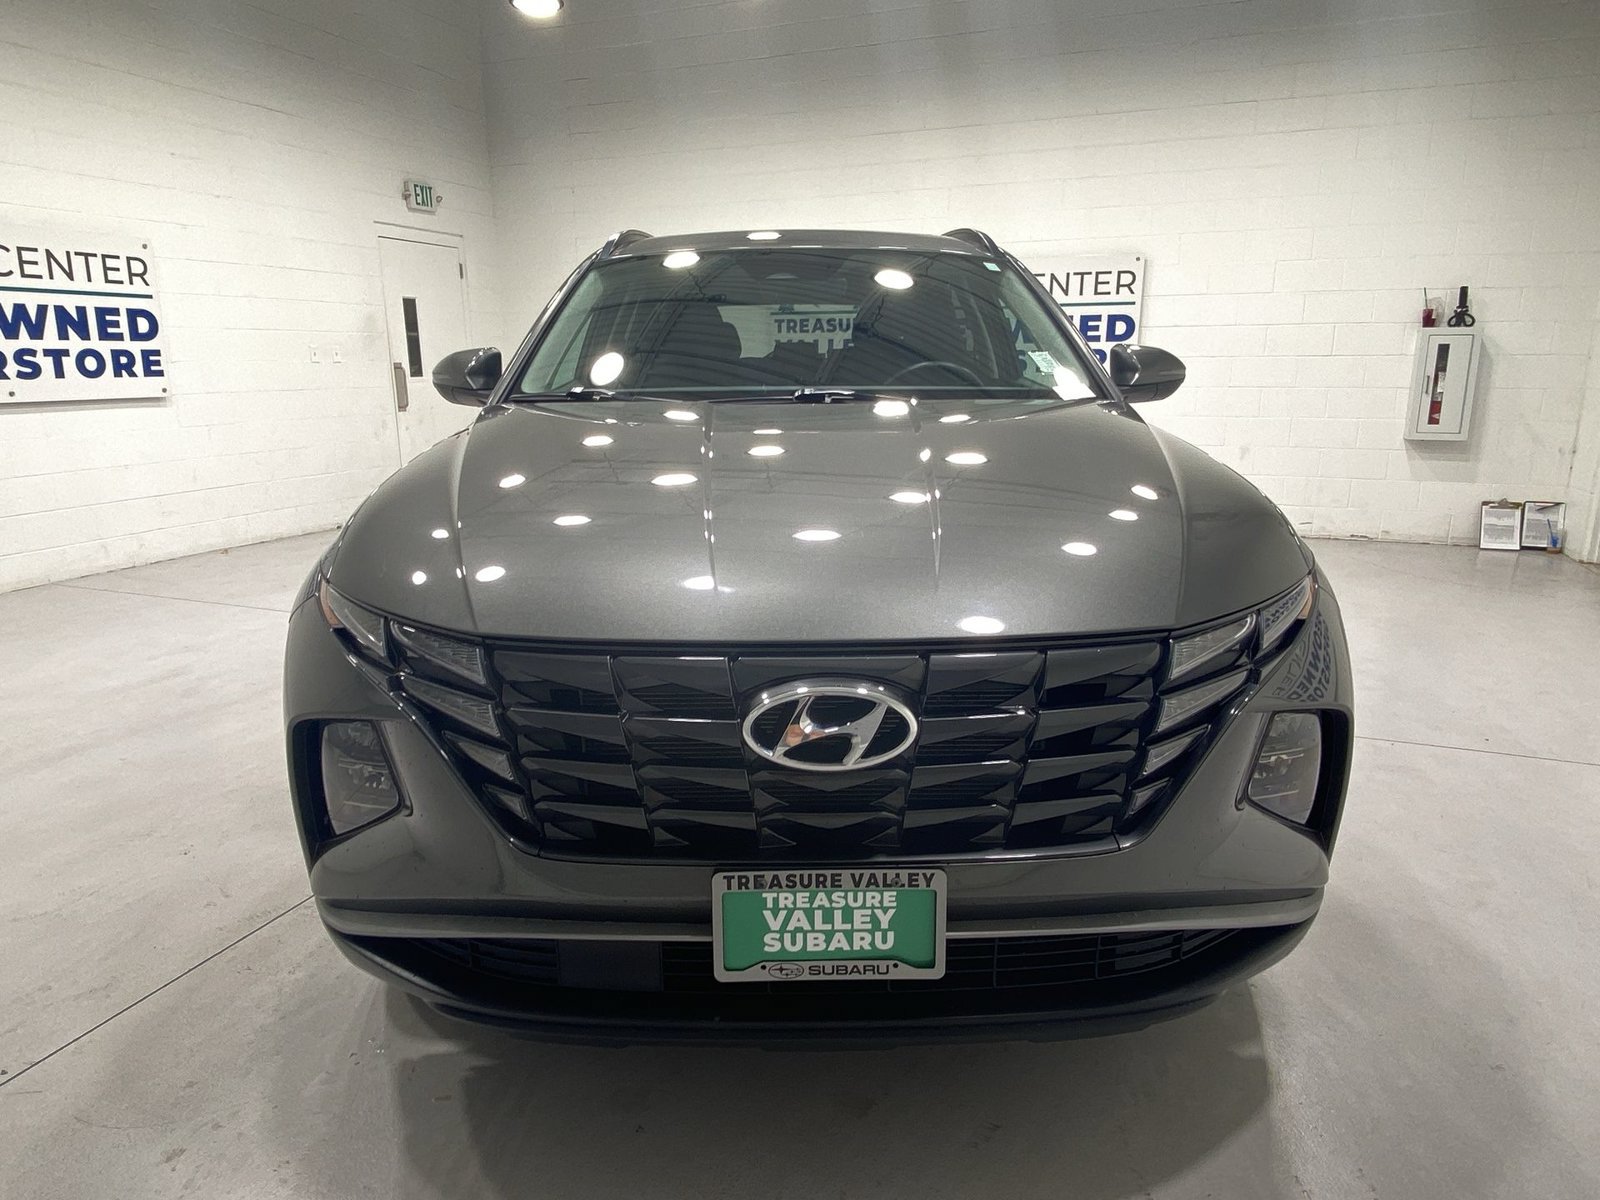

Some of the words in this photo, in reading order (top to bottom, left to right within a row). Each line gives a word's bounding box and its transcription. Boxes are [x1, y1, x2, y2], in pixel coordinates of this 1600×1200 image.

[413, 183, 433, 208] EXIT
[0, 303, 159, 342] WNED
[1067, 314, 1136, 343] ED
[722, 873, 842, 890] TREASURE
[850, 872, 935, 888] VALLEY
[762, 891, 897, 908] TREASURE
[763, 909, 897, 931] VALLEY
[763, 931, 895, 952] SUBARU
[808, 964, 889, 976] SUBARU
